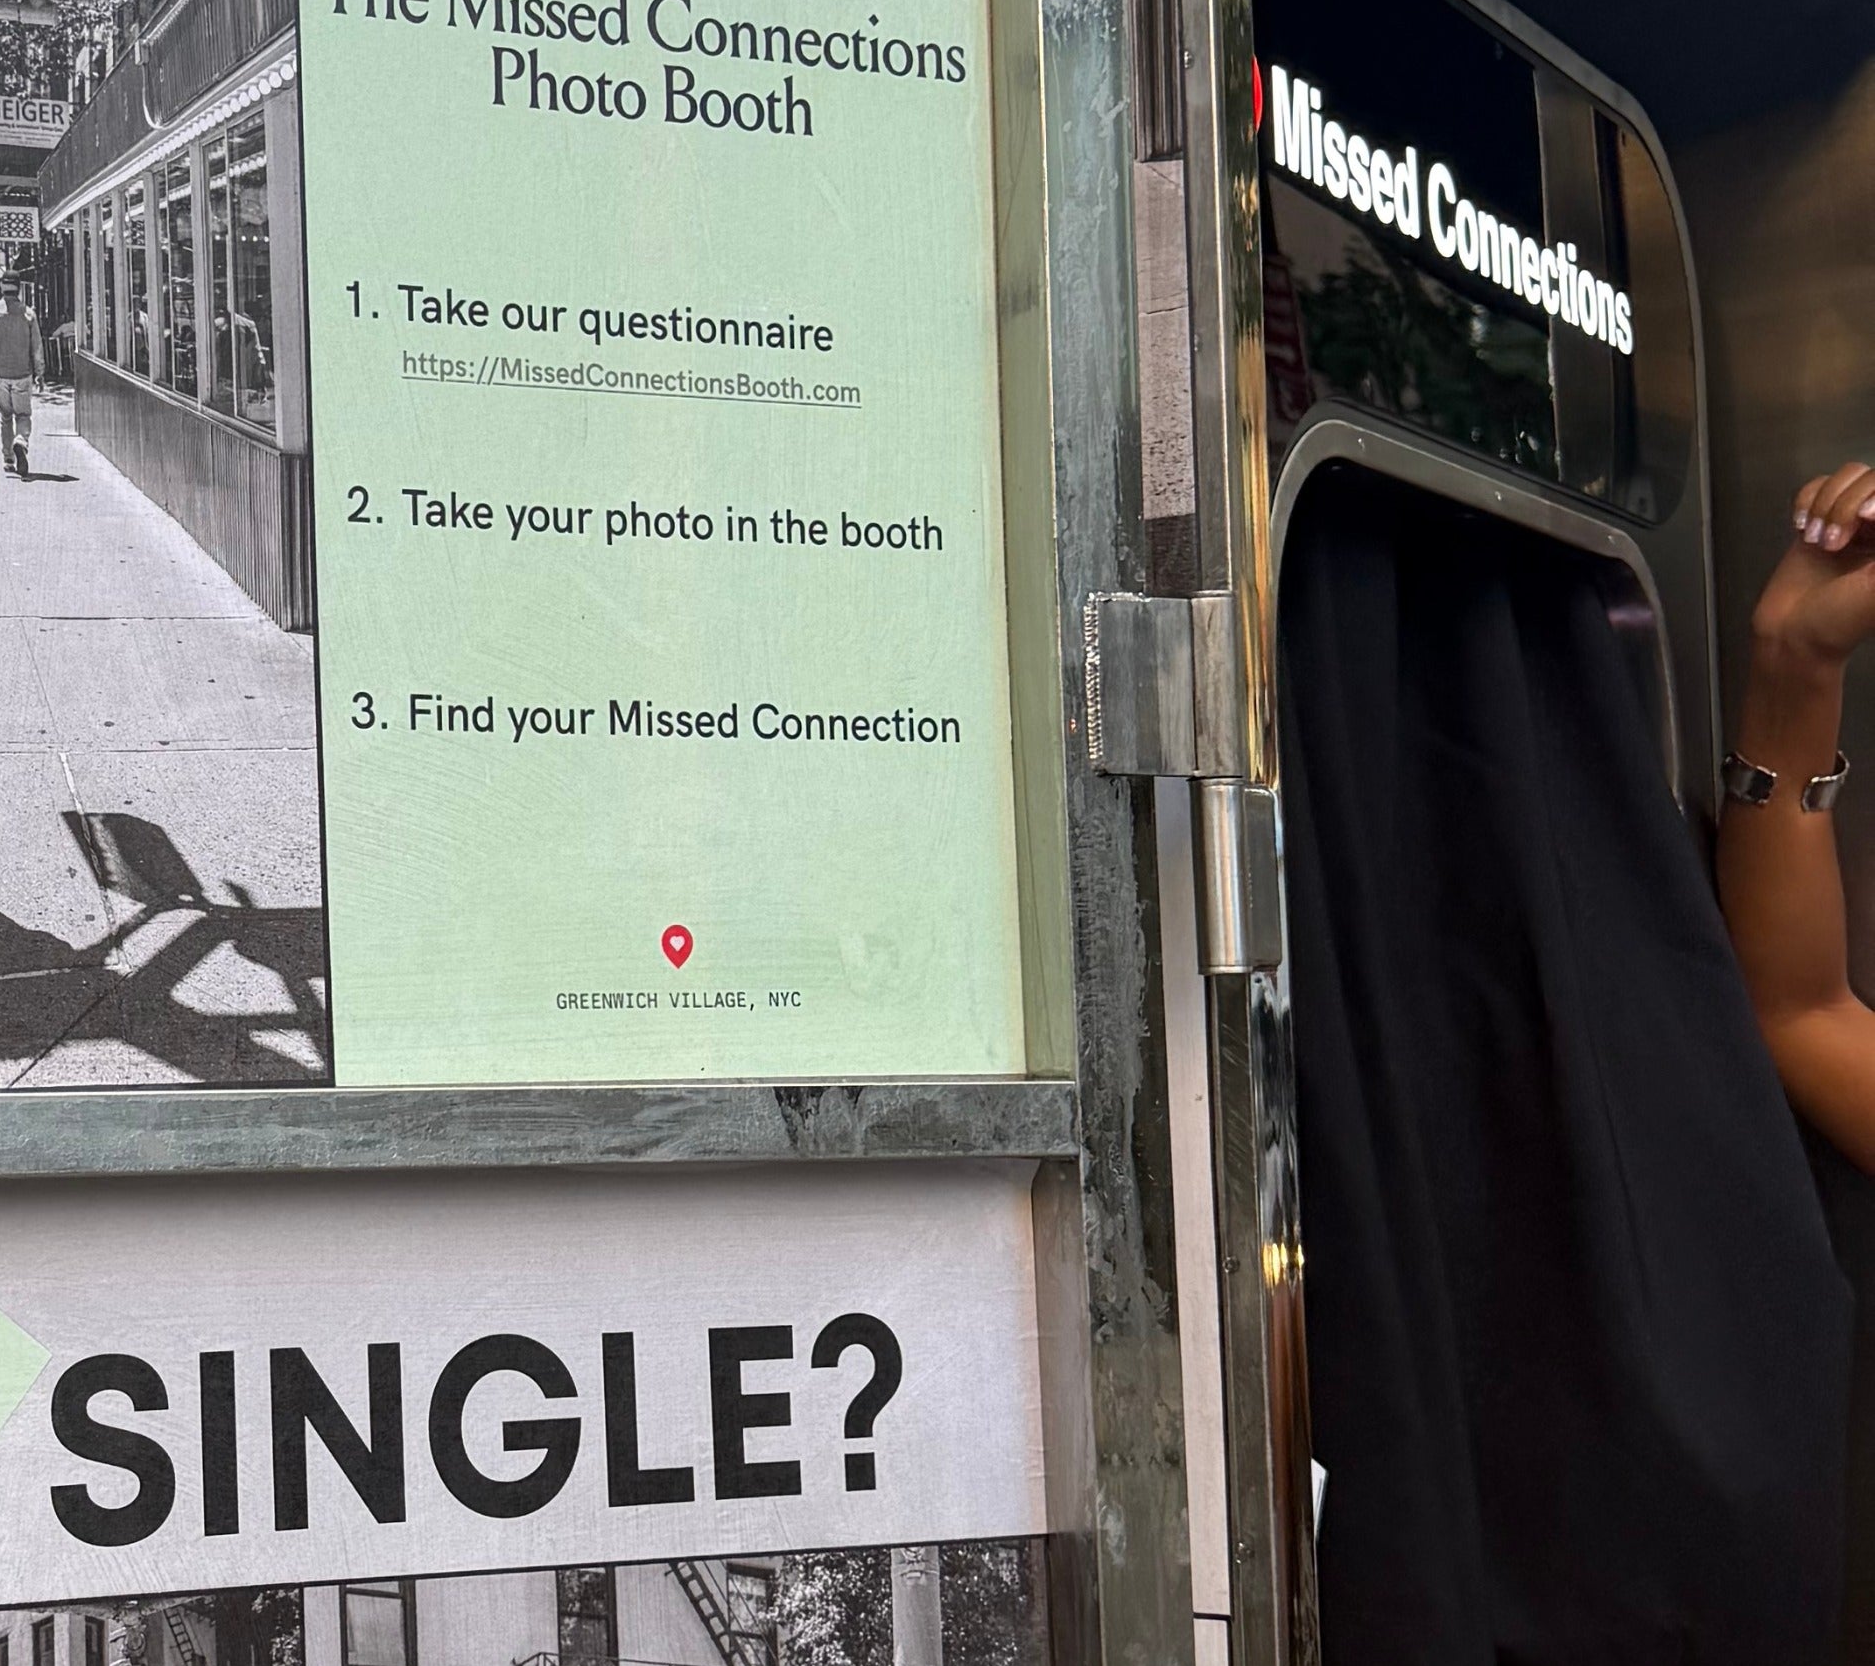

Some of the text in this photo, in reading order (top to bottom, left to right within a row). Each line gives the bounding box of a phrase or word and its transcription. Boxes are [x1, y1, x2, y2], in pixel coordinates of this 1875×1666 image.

[491, 46, 814, 137] Photo Booth
[1270, 64, 1634, 357] Missed Connections
[346, 281, 835, 352] 1. Take our questionnaire
[401, 350, 863, 407] https://MissedConnectionsBooth.com
[346, 486, 944, 552] 2. Take your photo in the booth
[350, 692, 962, 744] 3. Find your Missed Connection
[555, 991, 803, 1012] GREENWICH VILLAGE, NYC
[49, 1312, 904, 1549] SINGLE?
